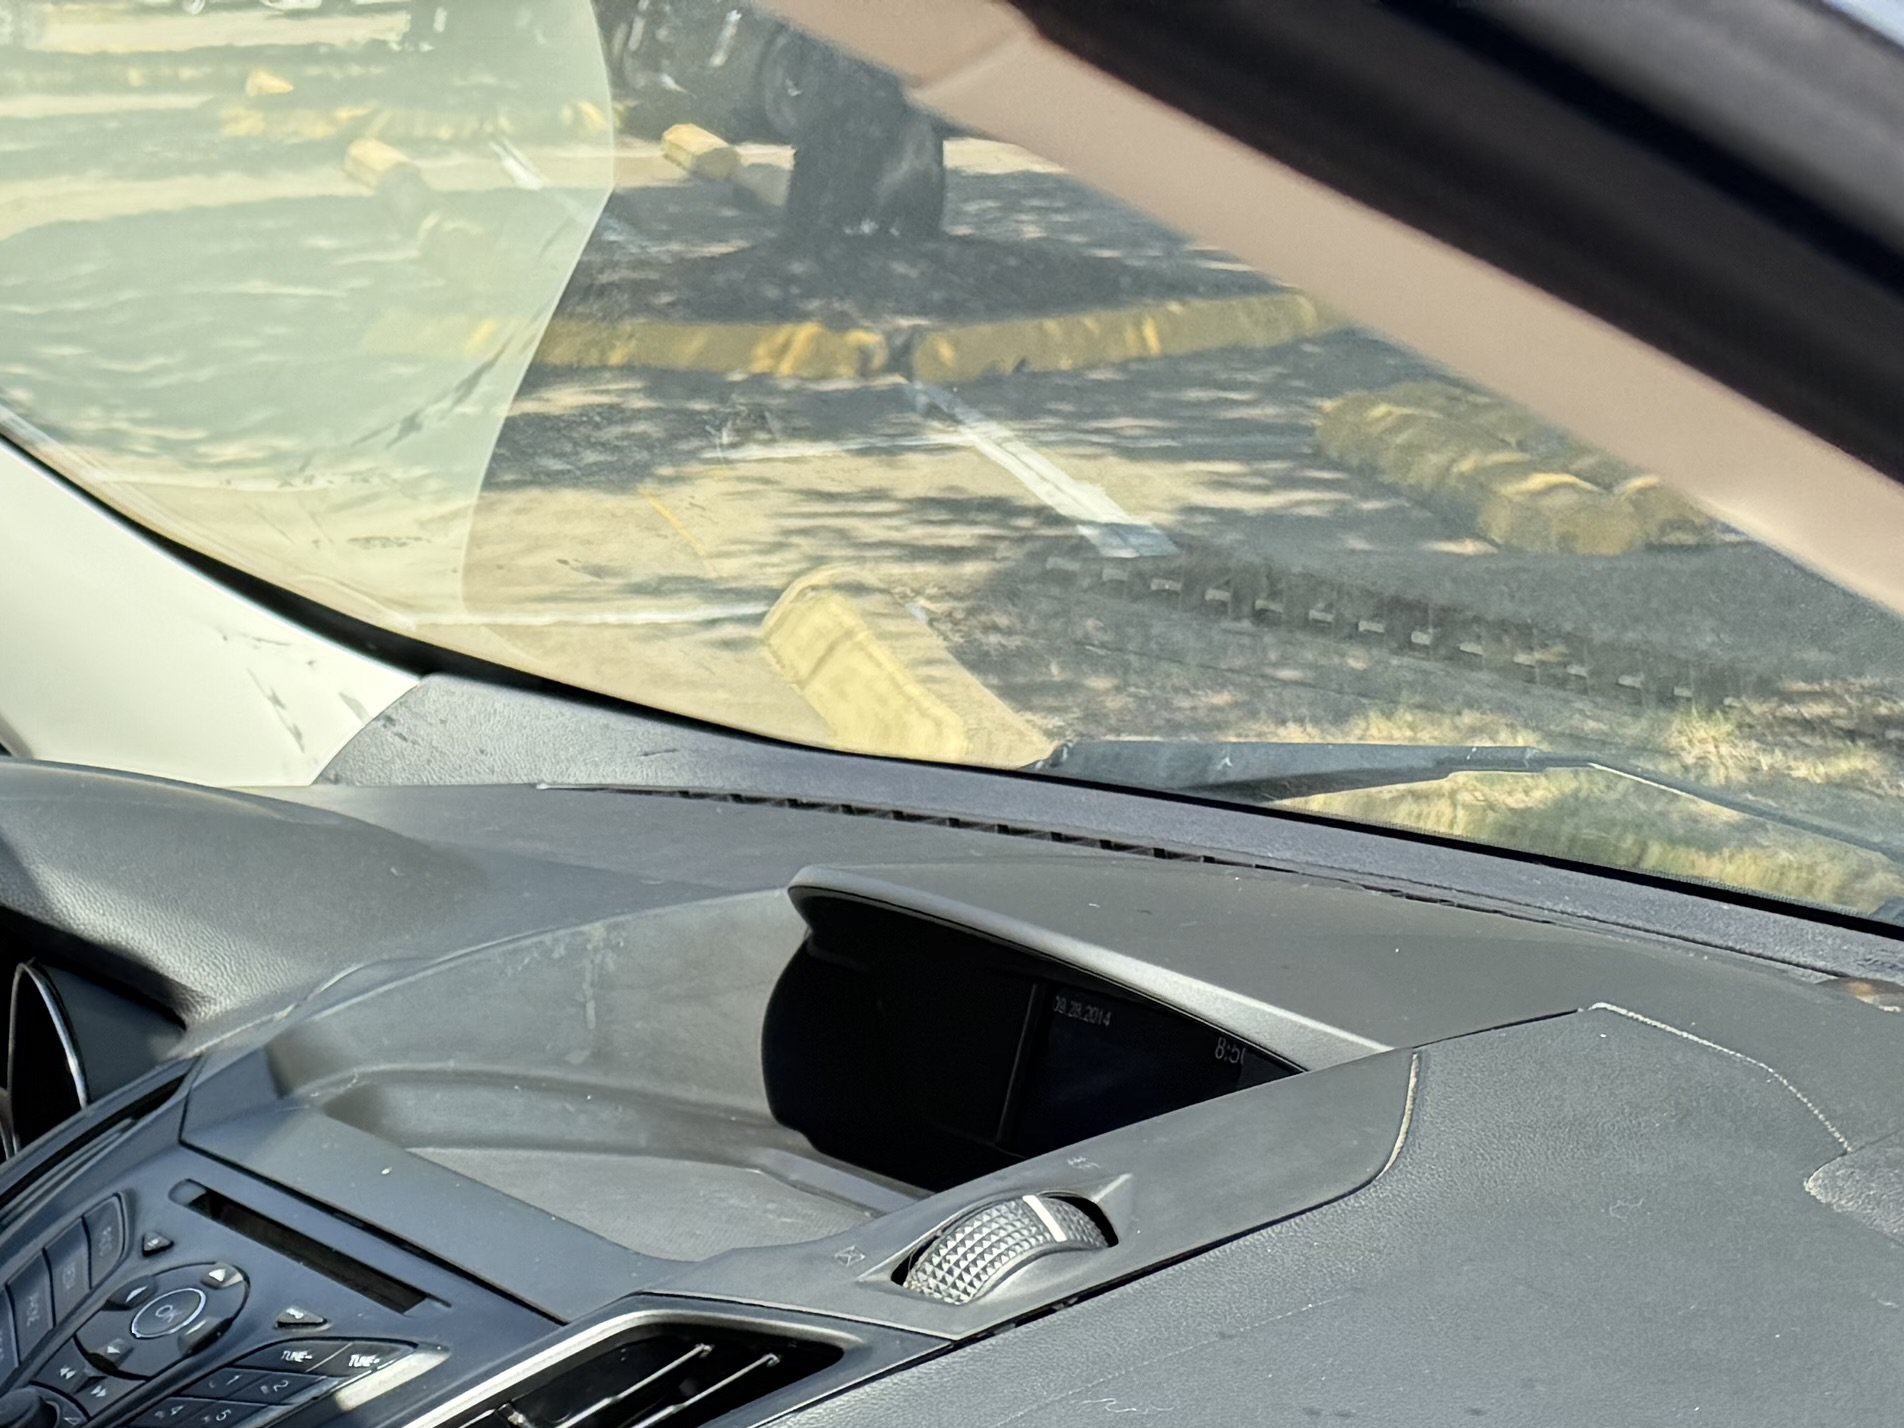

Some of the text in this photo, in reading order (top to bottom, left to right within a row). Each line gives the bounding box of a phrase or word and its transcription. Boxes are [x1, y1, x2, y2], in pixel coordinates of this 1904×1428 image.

[1214, 1036, 1246, 1065] 8:5
[154, 1304, 184, 1323] OK
[272, 1379, 289, 1392] 2
[170, 1404, 185, 1416] 4
[215, 1408, 232, 1422] 5
